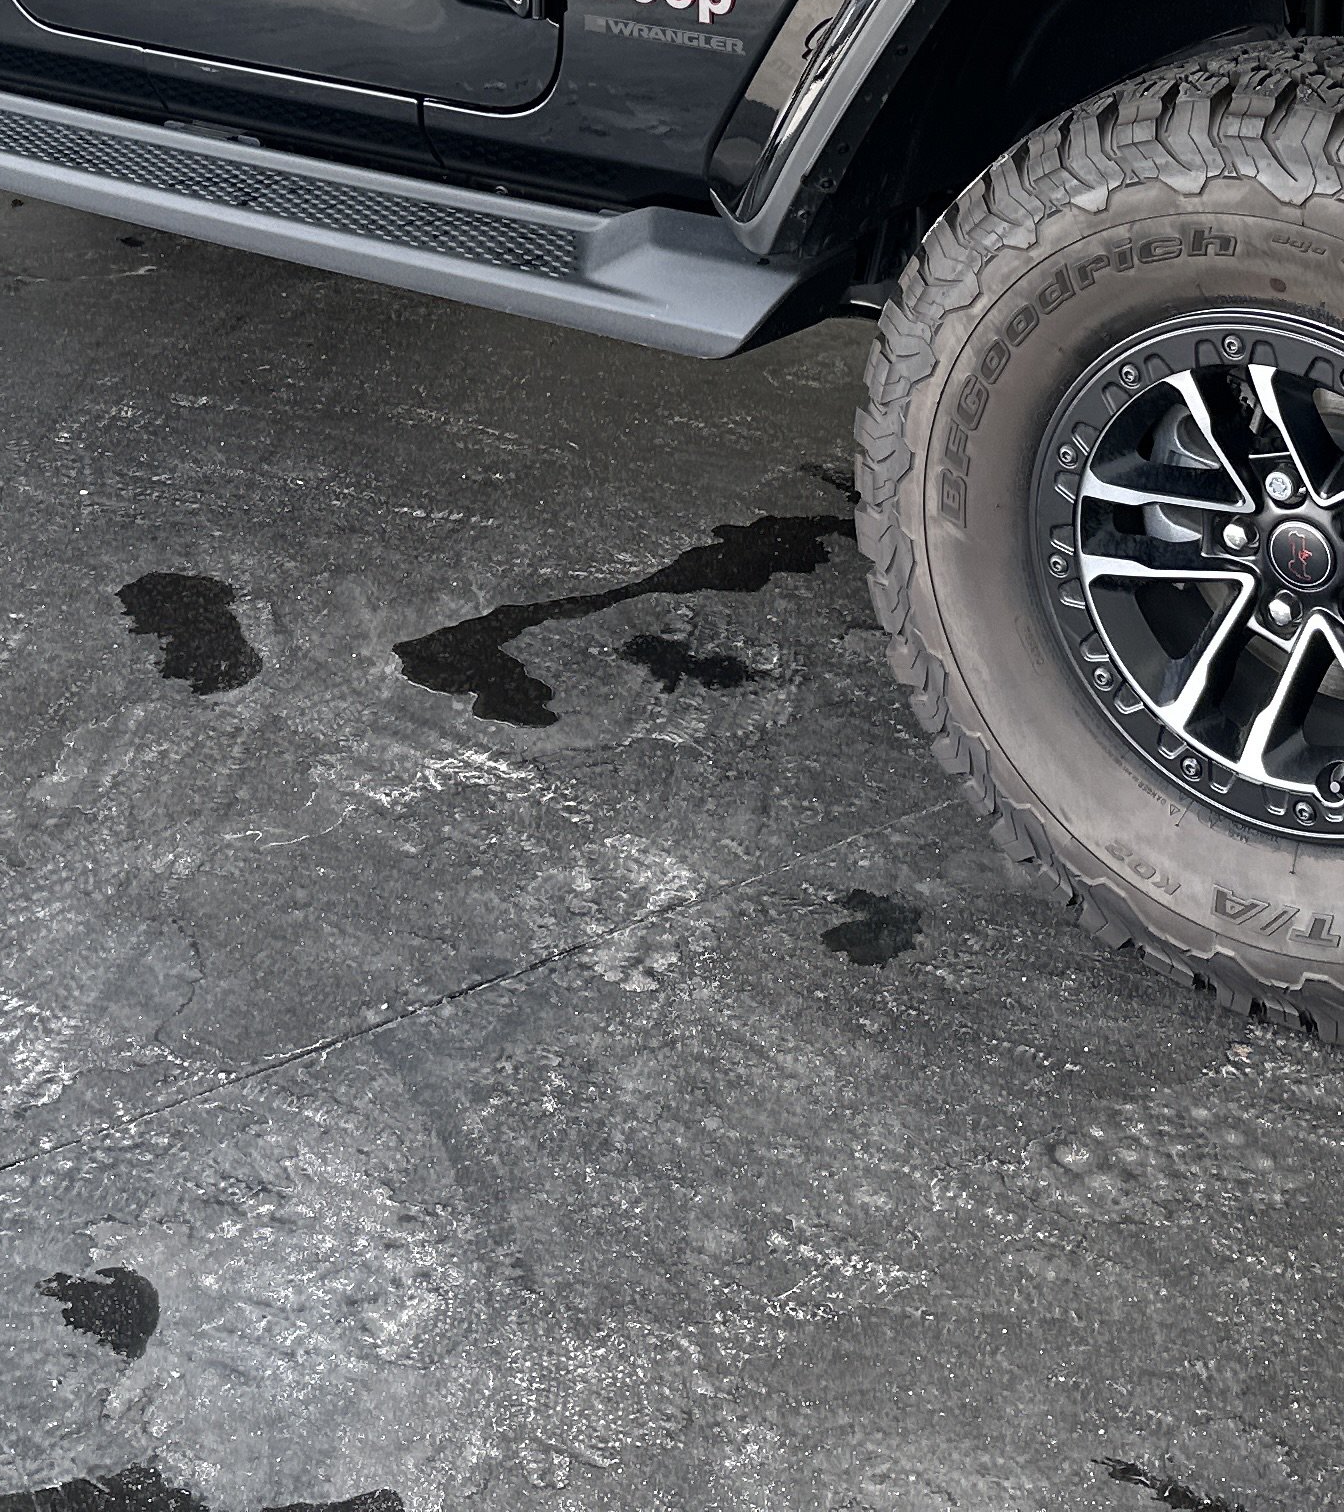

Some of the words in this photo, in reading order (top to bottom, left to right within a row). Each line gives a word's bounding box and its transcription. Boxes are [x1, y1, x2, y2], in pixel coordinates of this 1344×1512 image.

[605, 17, 746, 56] WRANGLER
[1271, 236, 1327, 256] Baja
[938, 225, 1239, 529] BFGoodrich
[1210, 884, 1343, 949] T/A
